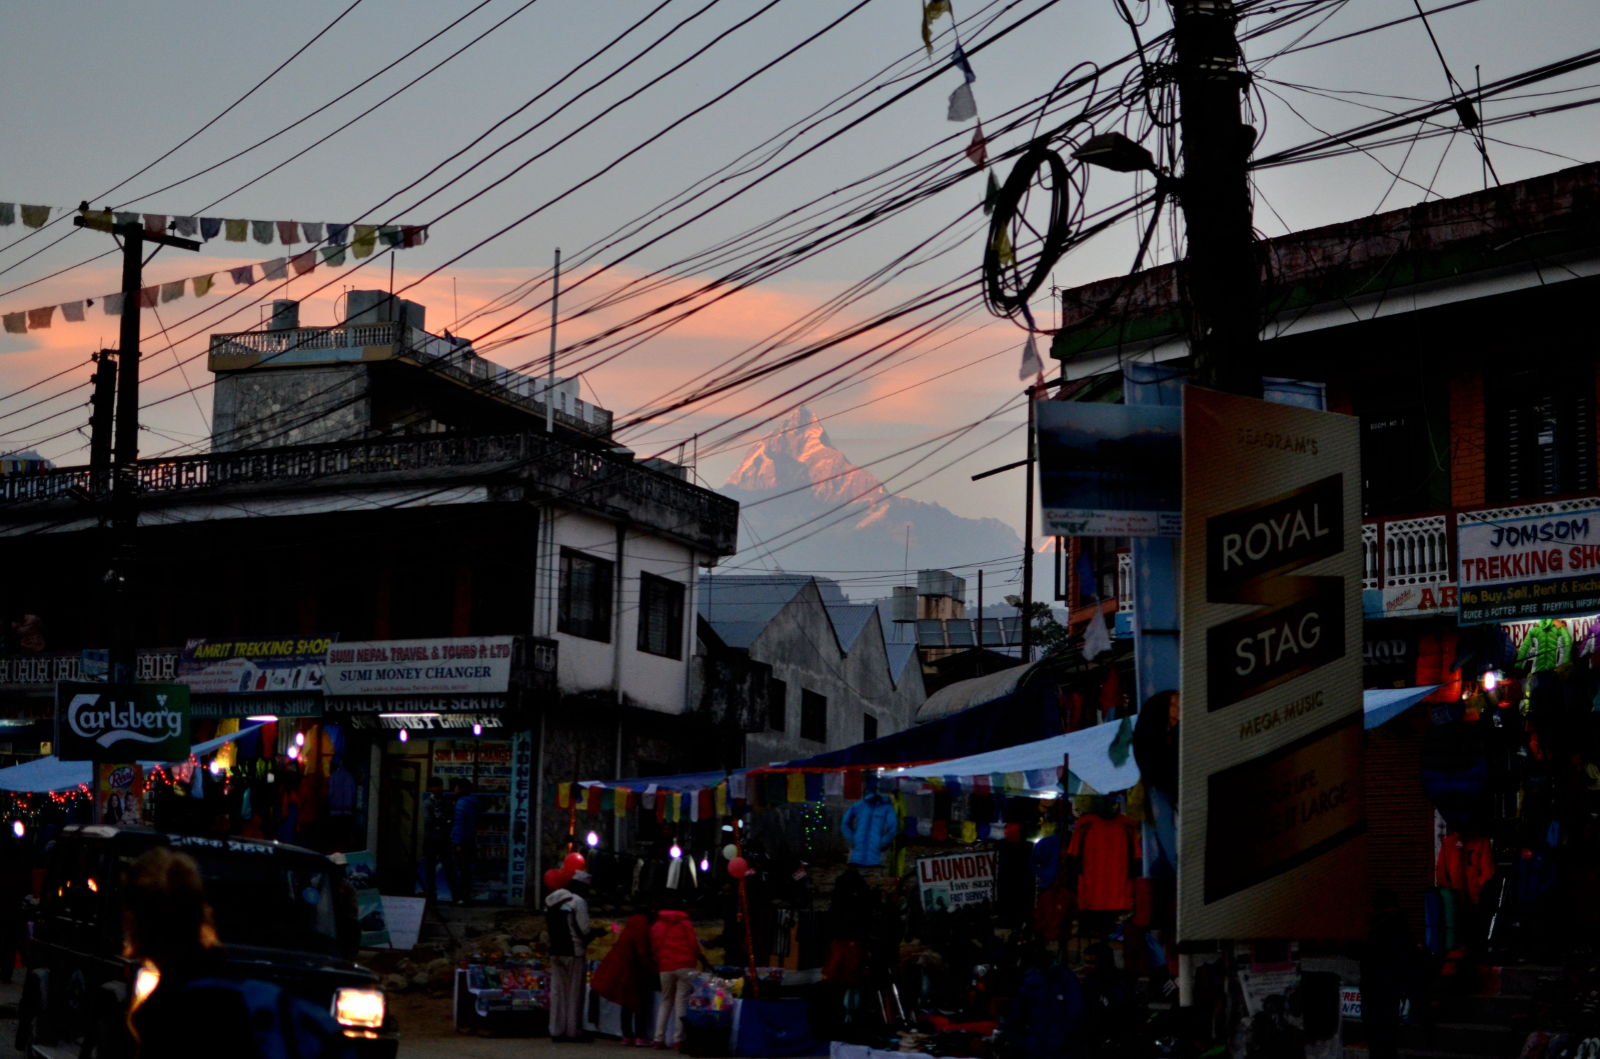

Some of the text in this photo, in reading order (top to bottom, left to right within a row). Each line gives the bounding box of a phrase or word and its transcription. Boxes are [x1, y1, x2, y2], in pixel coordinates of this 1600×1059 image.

[1222, 502, 1330, 572] ROYAL
[1490, 518, 1589, 547] JOMSOM
[1462, 549, 1563, 583] TREKKING
[193, 638, 332, 659] AMRIT TREKKING SHOP
[330, 648, 354, 663] SUMI
[356, 647, 388, 662] NEPAL
[391, 646, 429, 661] TRAVEL
[431, 646, 439, 659] &
[442, 645, 477, 660] TOURS
[490, 644, 511, 658] LTD
[1235, 611, 1321, 677] STAG
[339, 665, 492, 681] SUMI MONEY CHANGER
[67, 692, 183, 742] Carlsberg
[228, 700, 281, 716] TREKKING
[282, 699, 315, 714] SHOP
[324, 697, 384, 712] POTALA
[386, 696, 448, 712] VEHICLE
[1239, 690, 1325, 739] MEGA MUSIC
[1299, 781, 1350, 822] LARGE
[921, 855, 996, 883] LAUNDRY
